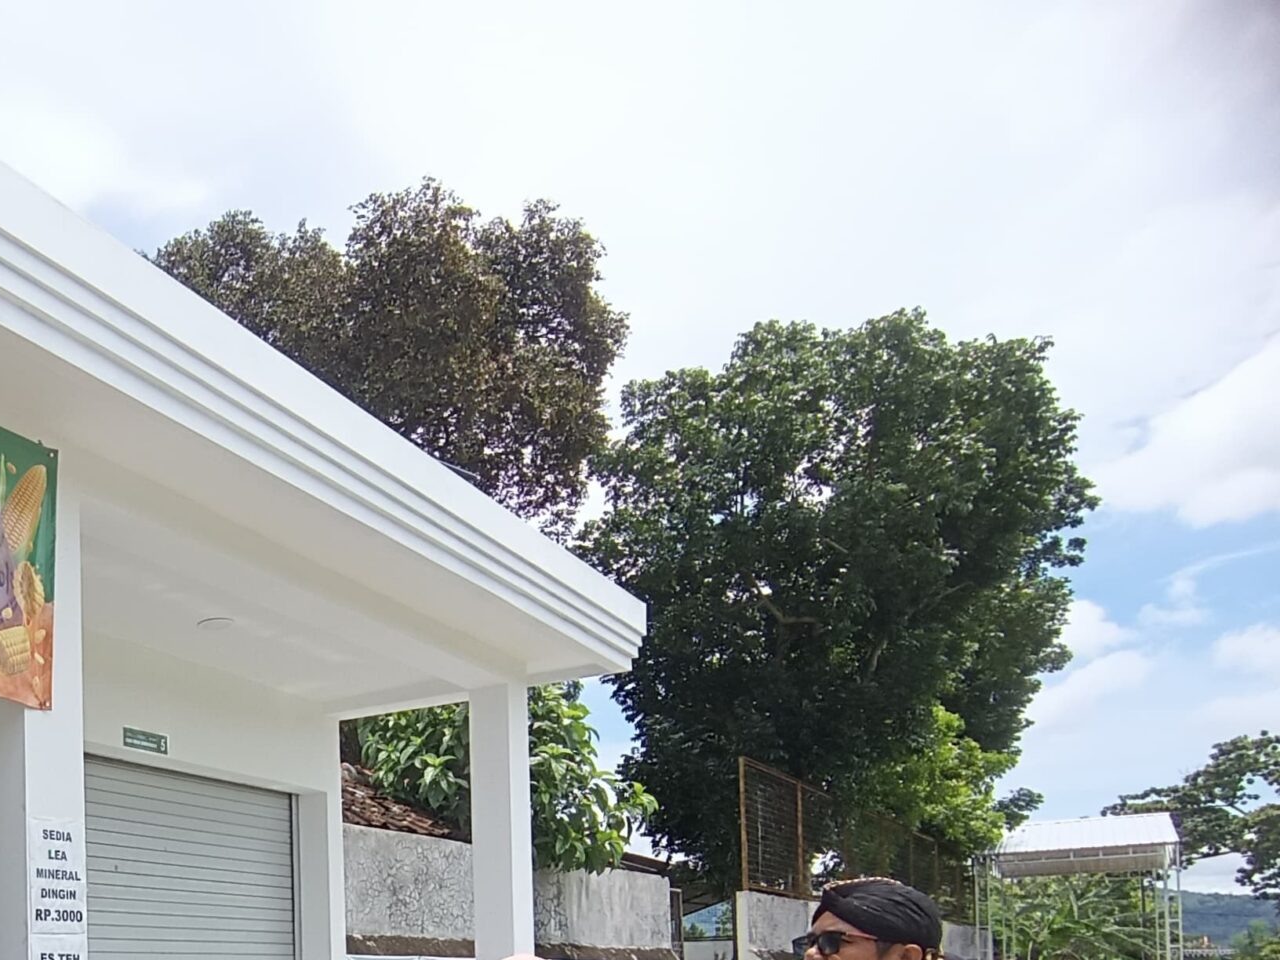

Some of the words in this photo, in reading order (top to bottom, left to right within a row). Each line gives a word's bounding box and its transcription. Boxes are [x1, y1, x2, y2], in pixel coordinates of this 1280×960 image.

[42, 829, 72, 843] SEDIA
[48, 849, 67, 861] LEA
[36, 868, 81, 881] MINERAL
[41, 888, 76, 900] DINGIN
[35, 909, 83, 923] RP.3000
